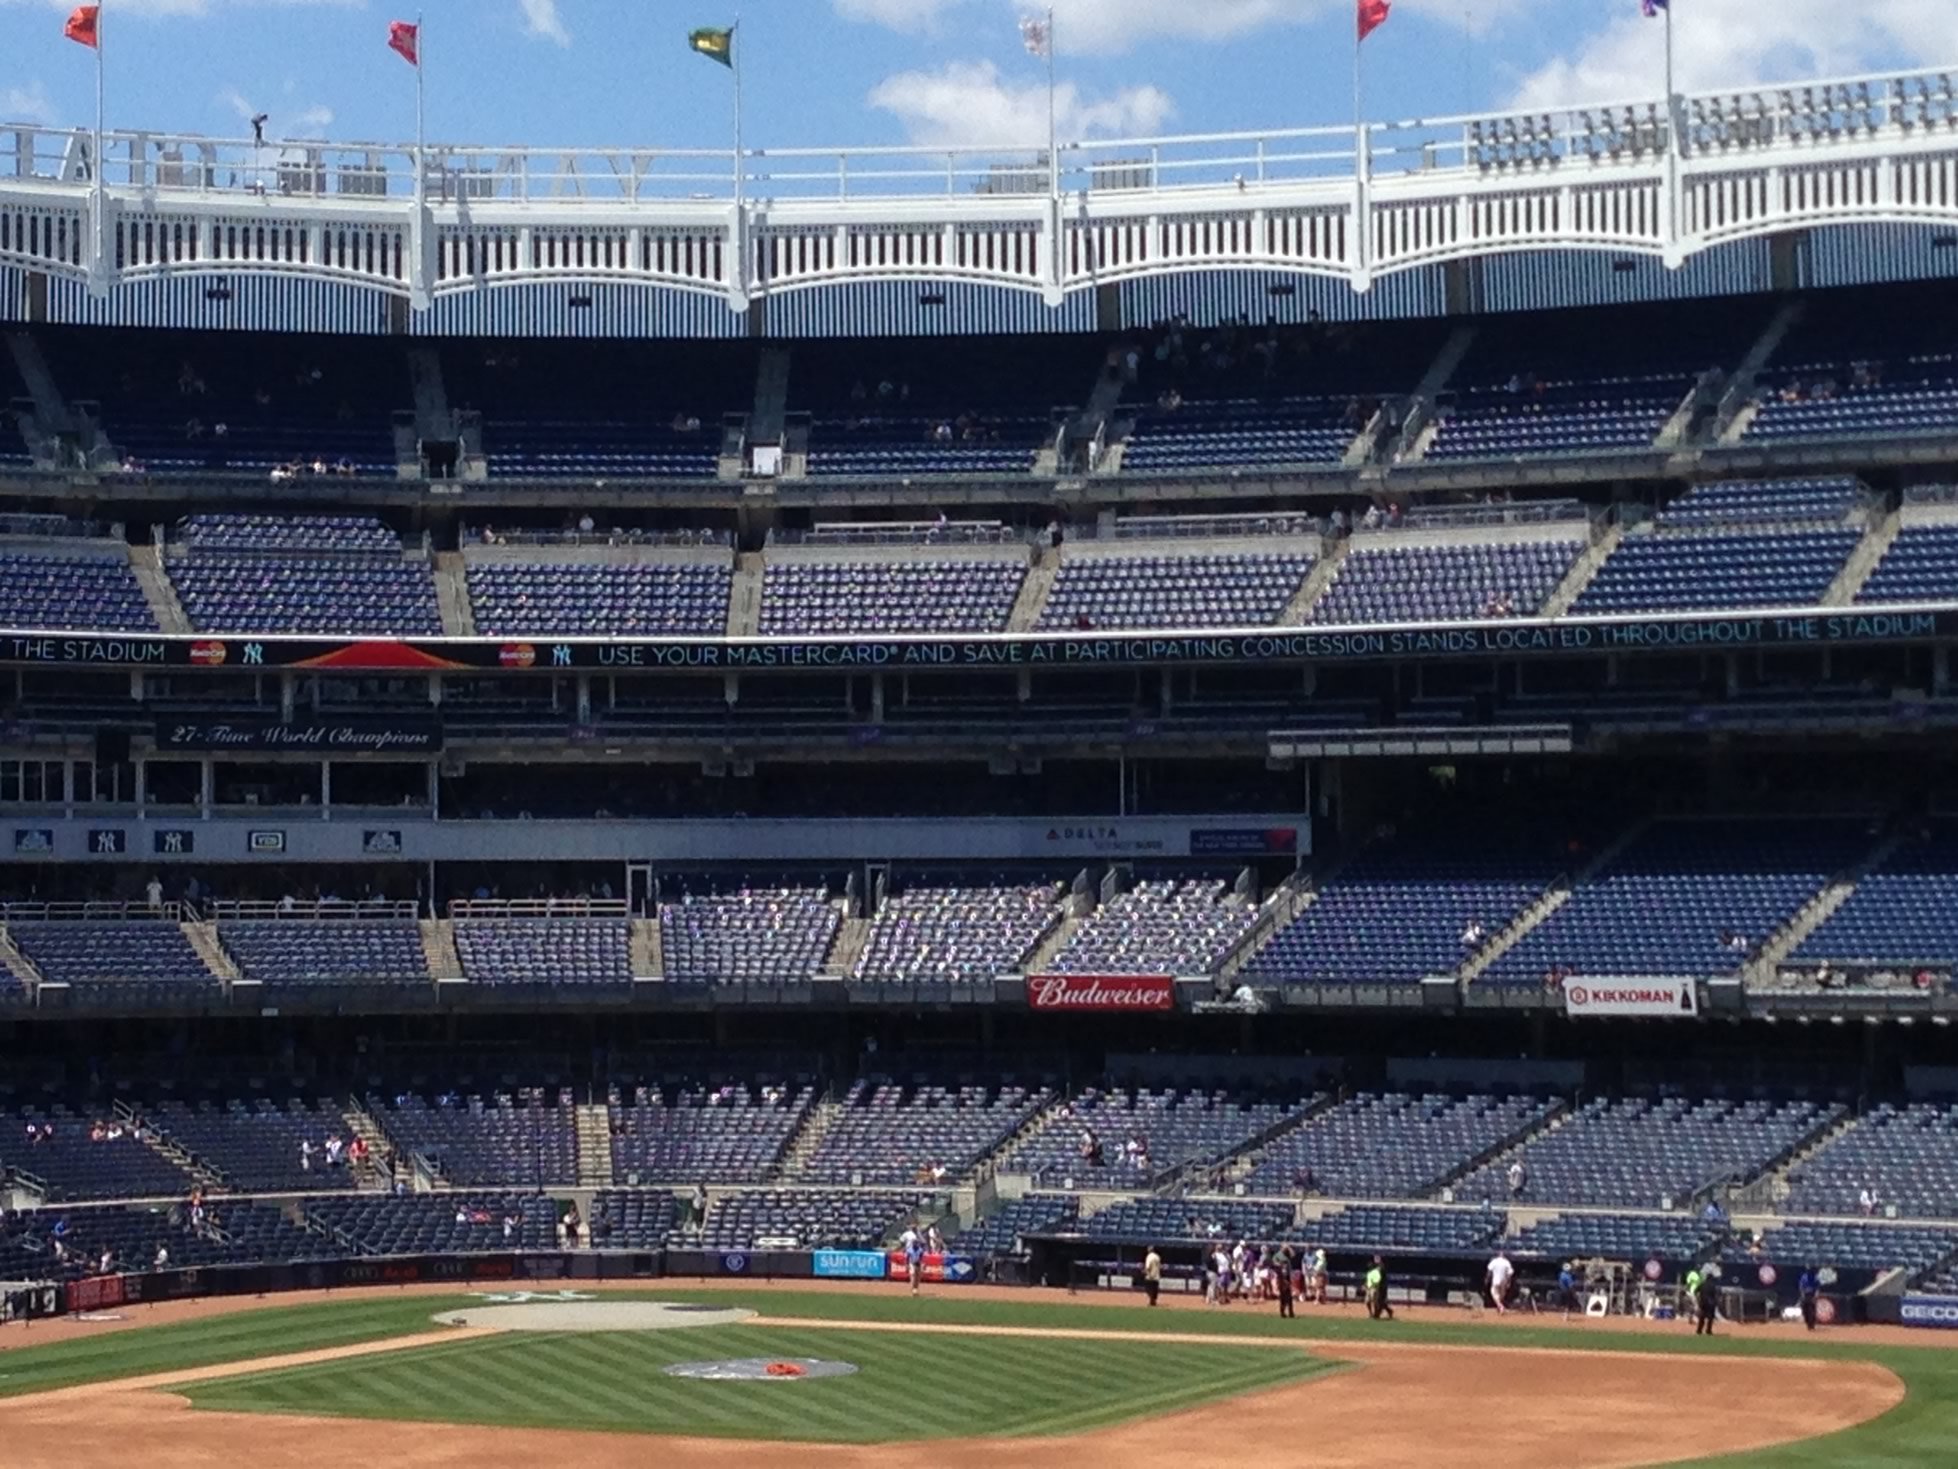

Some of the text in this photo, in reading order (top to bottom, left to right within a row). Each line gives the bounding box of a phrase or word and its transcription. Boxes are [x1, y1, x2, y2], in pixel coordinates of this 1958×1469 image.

[13, 639, 165, 661] THE STADIUM
[599, 646, 644, 665] USE
[652, 646, 718, 665] YOUR
[903, 643, 956, 664] AND
[963, 642, 1023, 663] SAVE
[1030, 642, 1056, 661] AT
[1065, 639, 1234, 661] PARTICIPATING
[1241, 634, 1384, 657] CONCESSION
[1389, 632, 1479, 652] STANDS
[1483, 627, 1591, 650] LOCATED
[1601, 621, 1765, 646] THROUGHOUT
[1775, 618, 1820, 639] THE
[1827, 614, 1936, 638] STADIUM
[261, 726, 325, 743] World
[329, 727, 429, 749] Champions
[1064, 828, 1118, 839] DELTA
[1030, 977, 1170, 1007] Budweiser
[1591, 989, 1675, 1003] KIKKOMAN
[820, 1253, 878, 1268] sunrun
